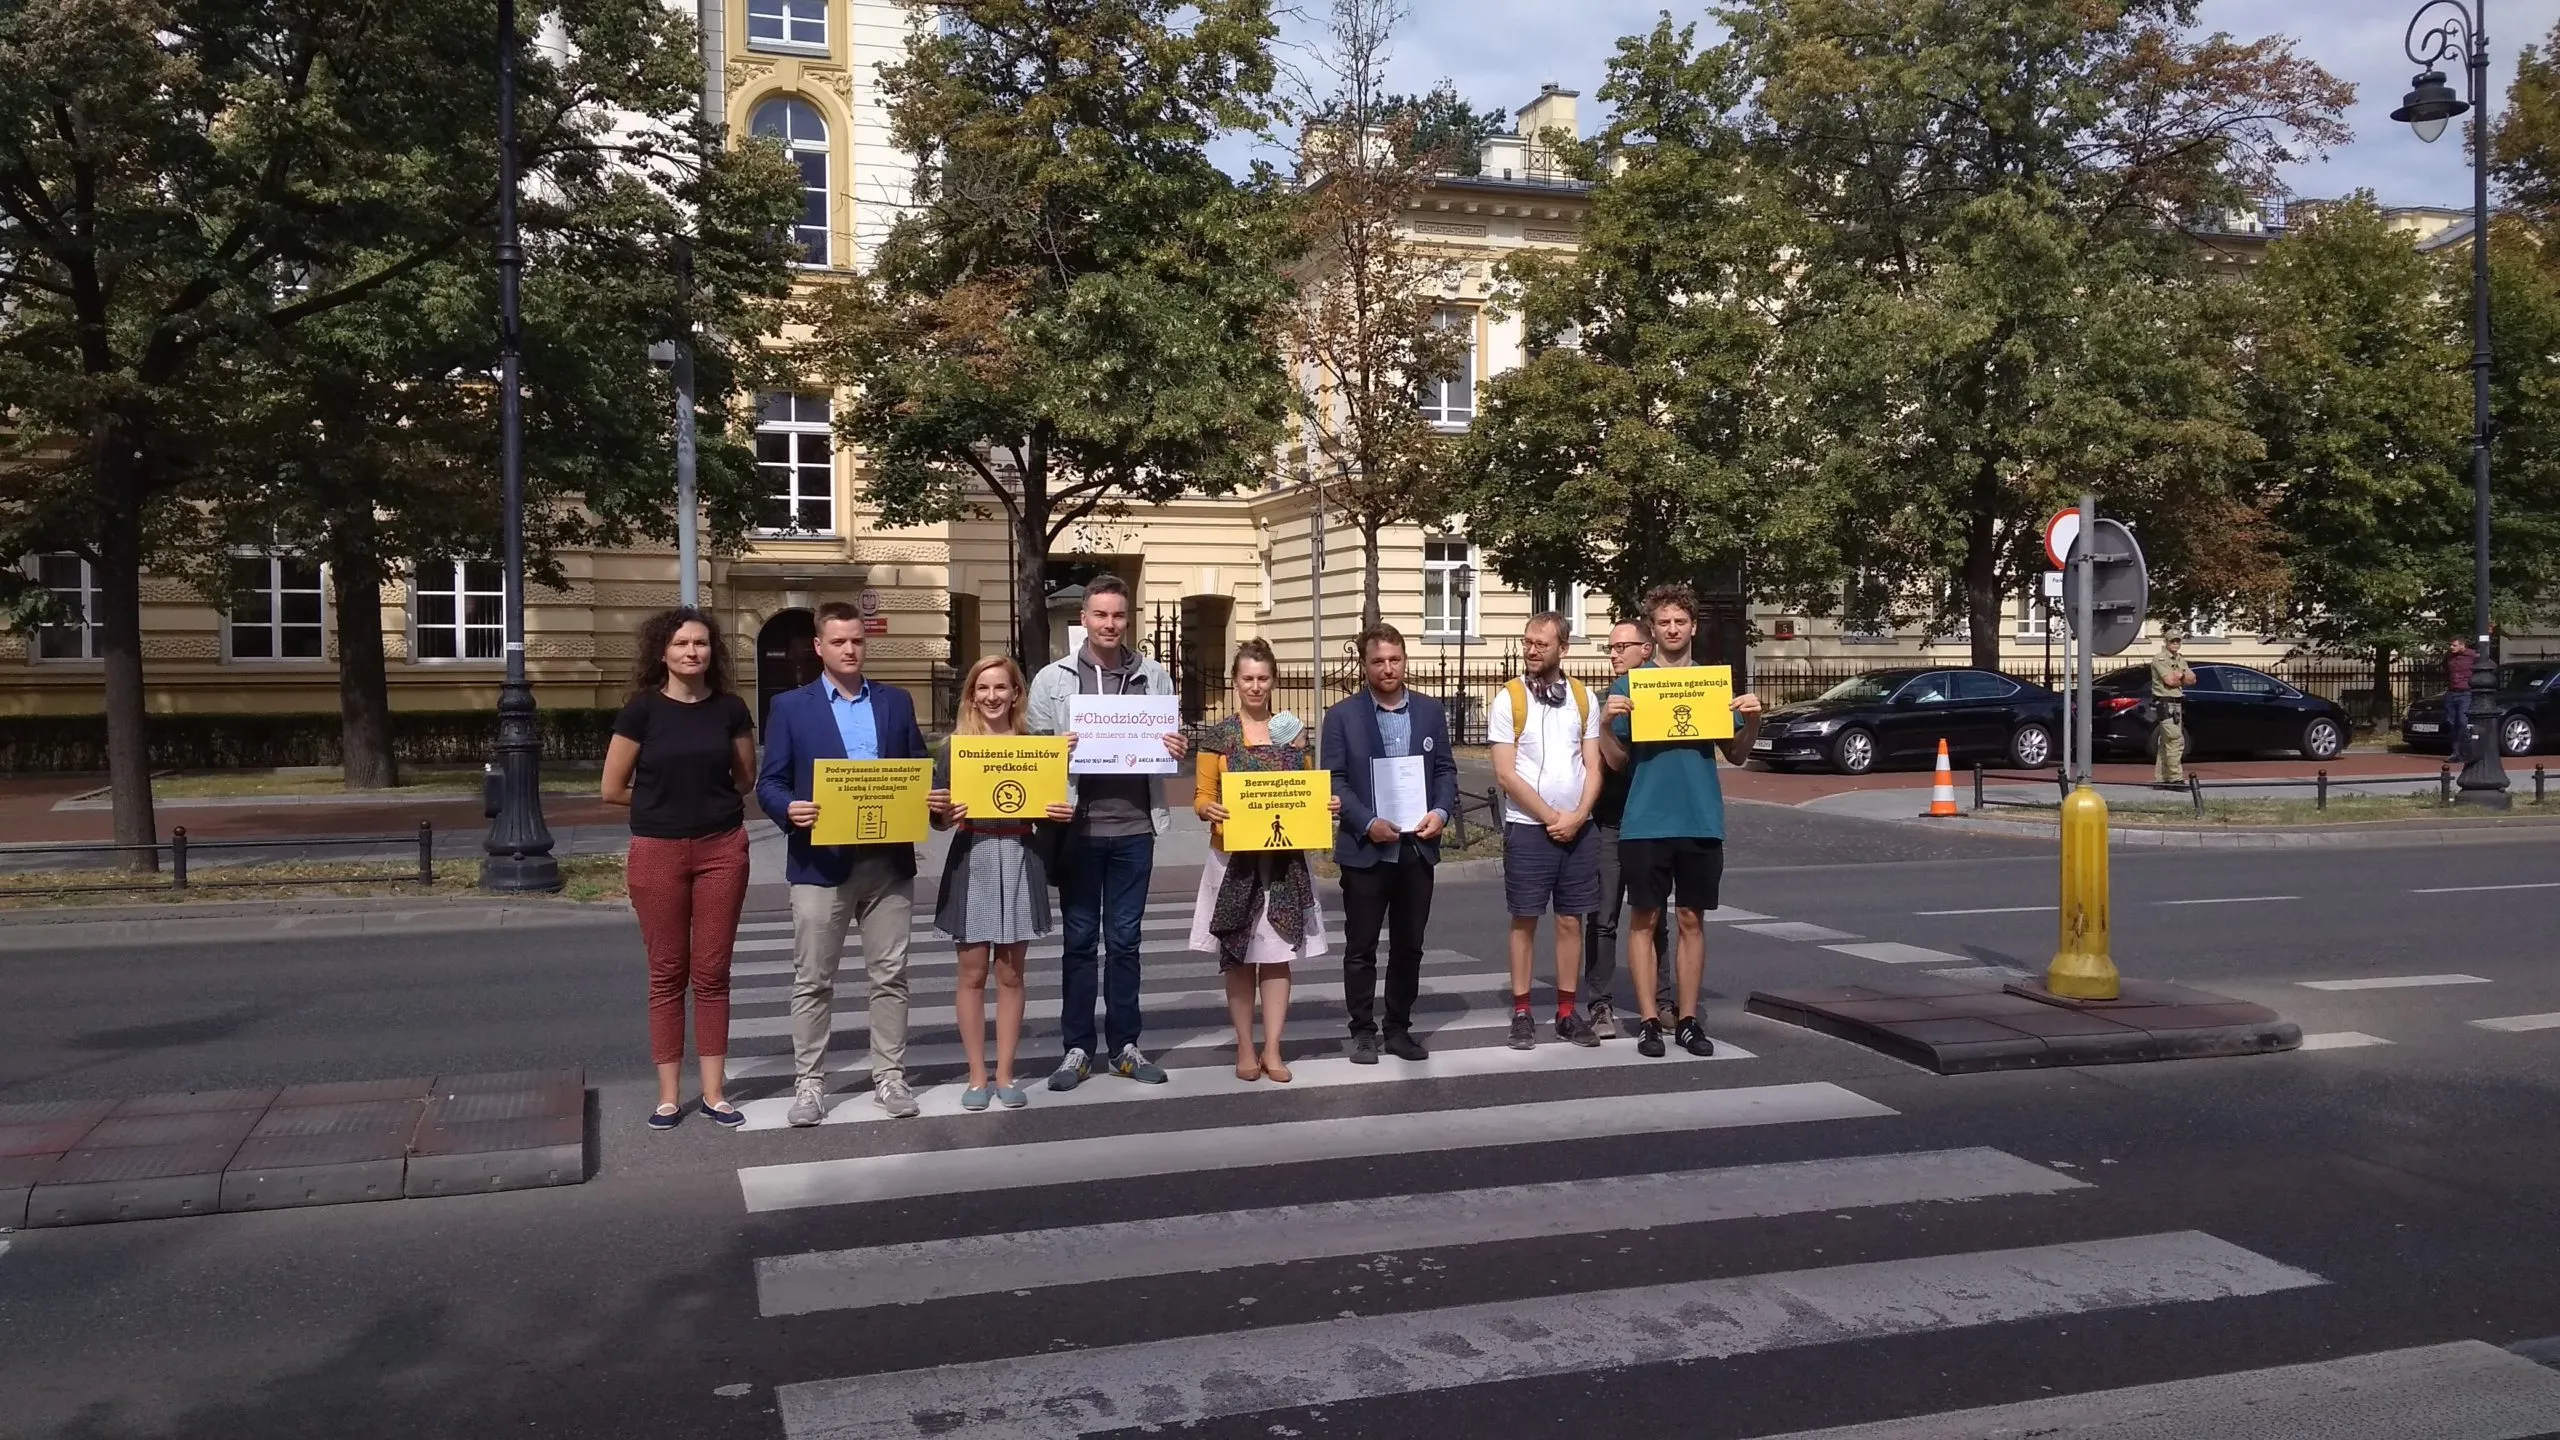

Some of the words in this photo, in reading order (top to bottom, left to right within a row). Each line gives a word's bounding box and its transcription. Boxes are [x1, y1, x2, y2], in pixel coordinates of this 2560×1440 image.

[1632, 680, 1682, 689] Prawdziwa
[1684, 679, 1728, 689] egzekucja
[1659, 690, 1705, 699] przepisów
[1074, 711, 1175, 726] #ChodzioŻycie
[958, 749, 1014, 759] Obniżenie
[1016, 749, 1060, 759] limitów
[825, 766, 880, 774] Podwyższenie
[983, 763, 1038, 773] prędkości
[845, 775, 888, 783] powiązanie
[1245, 778, 1306, 788] Bezwzględne
[844, 784, 866, 792] liczbą
[872, 784, 908, 792] rodzajem
[852, 793, 895, 801] wykroczeń
[1240, 789, 1311, 799] pierwszeństwo
[1248, 801, 1262, 809] dla
[1265, 801, 1306, 810] pieszych
